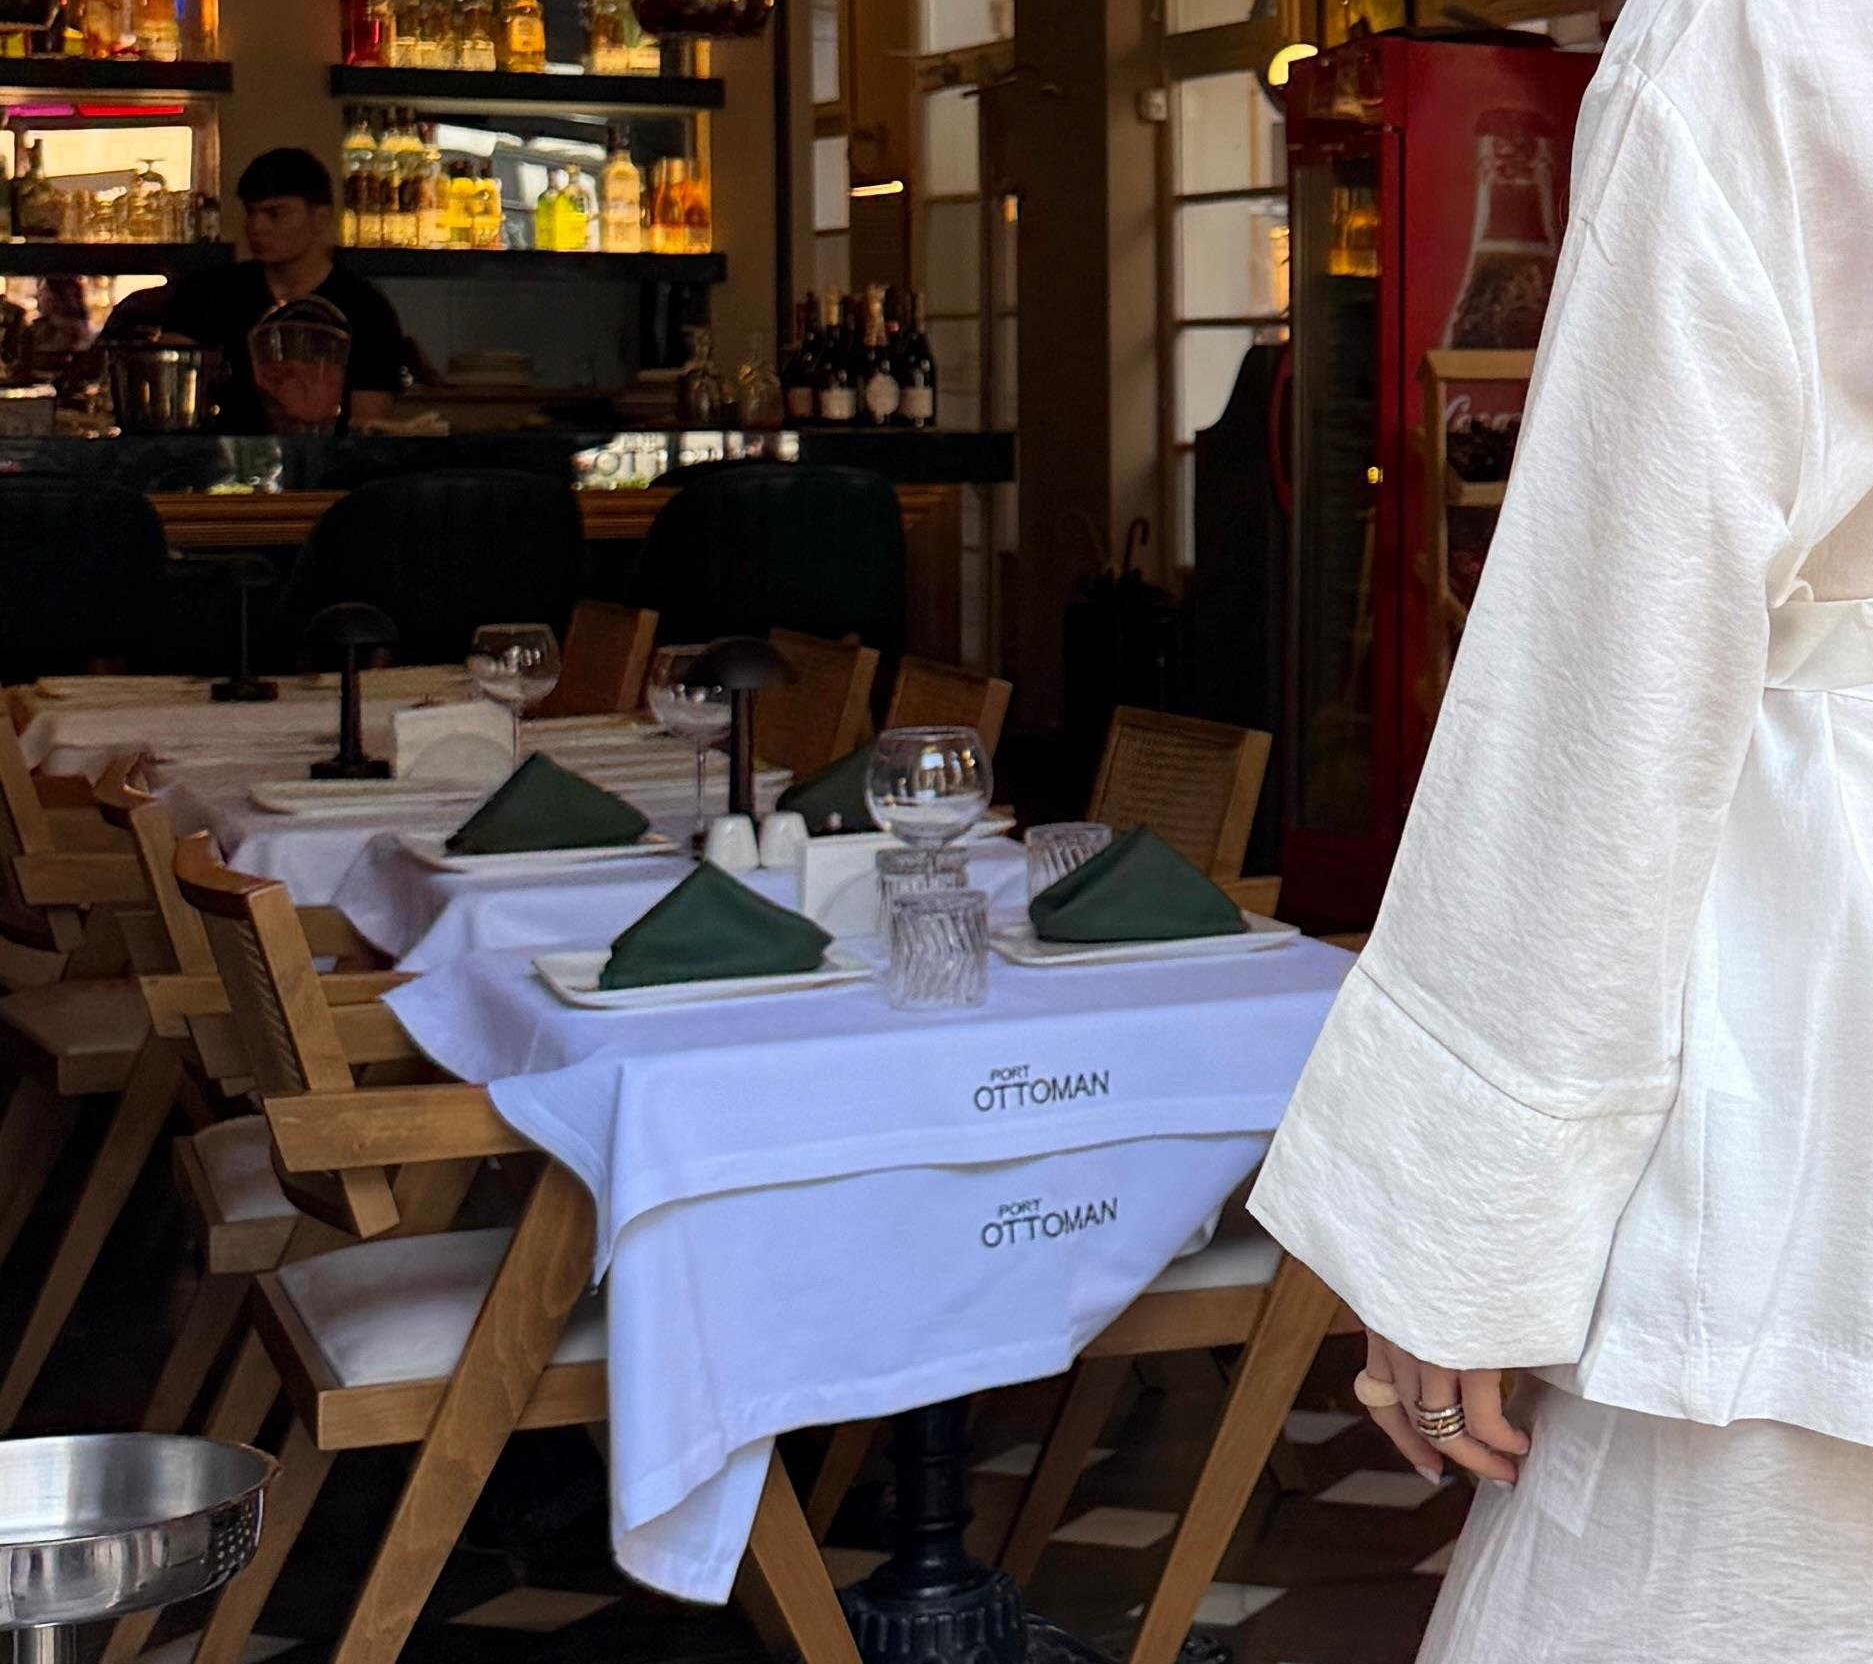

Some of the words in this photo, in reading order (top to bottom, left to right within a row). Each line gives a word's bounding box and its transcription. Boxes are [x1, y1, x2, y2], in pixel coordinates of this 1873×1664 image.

[989, 1064, 1031, 1082] PORT
[973, 1070, 1110, 1113] OTTOMAN
[981, 1196, 1118, 1249] OTTOMAN
[997, 1198, 1042, 1219] PORT
